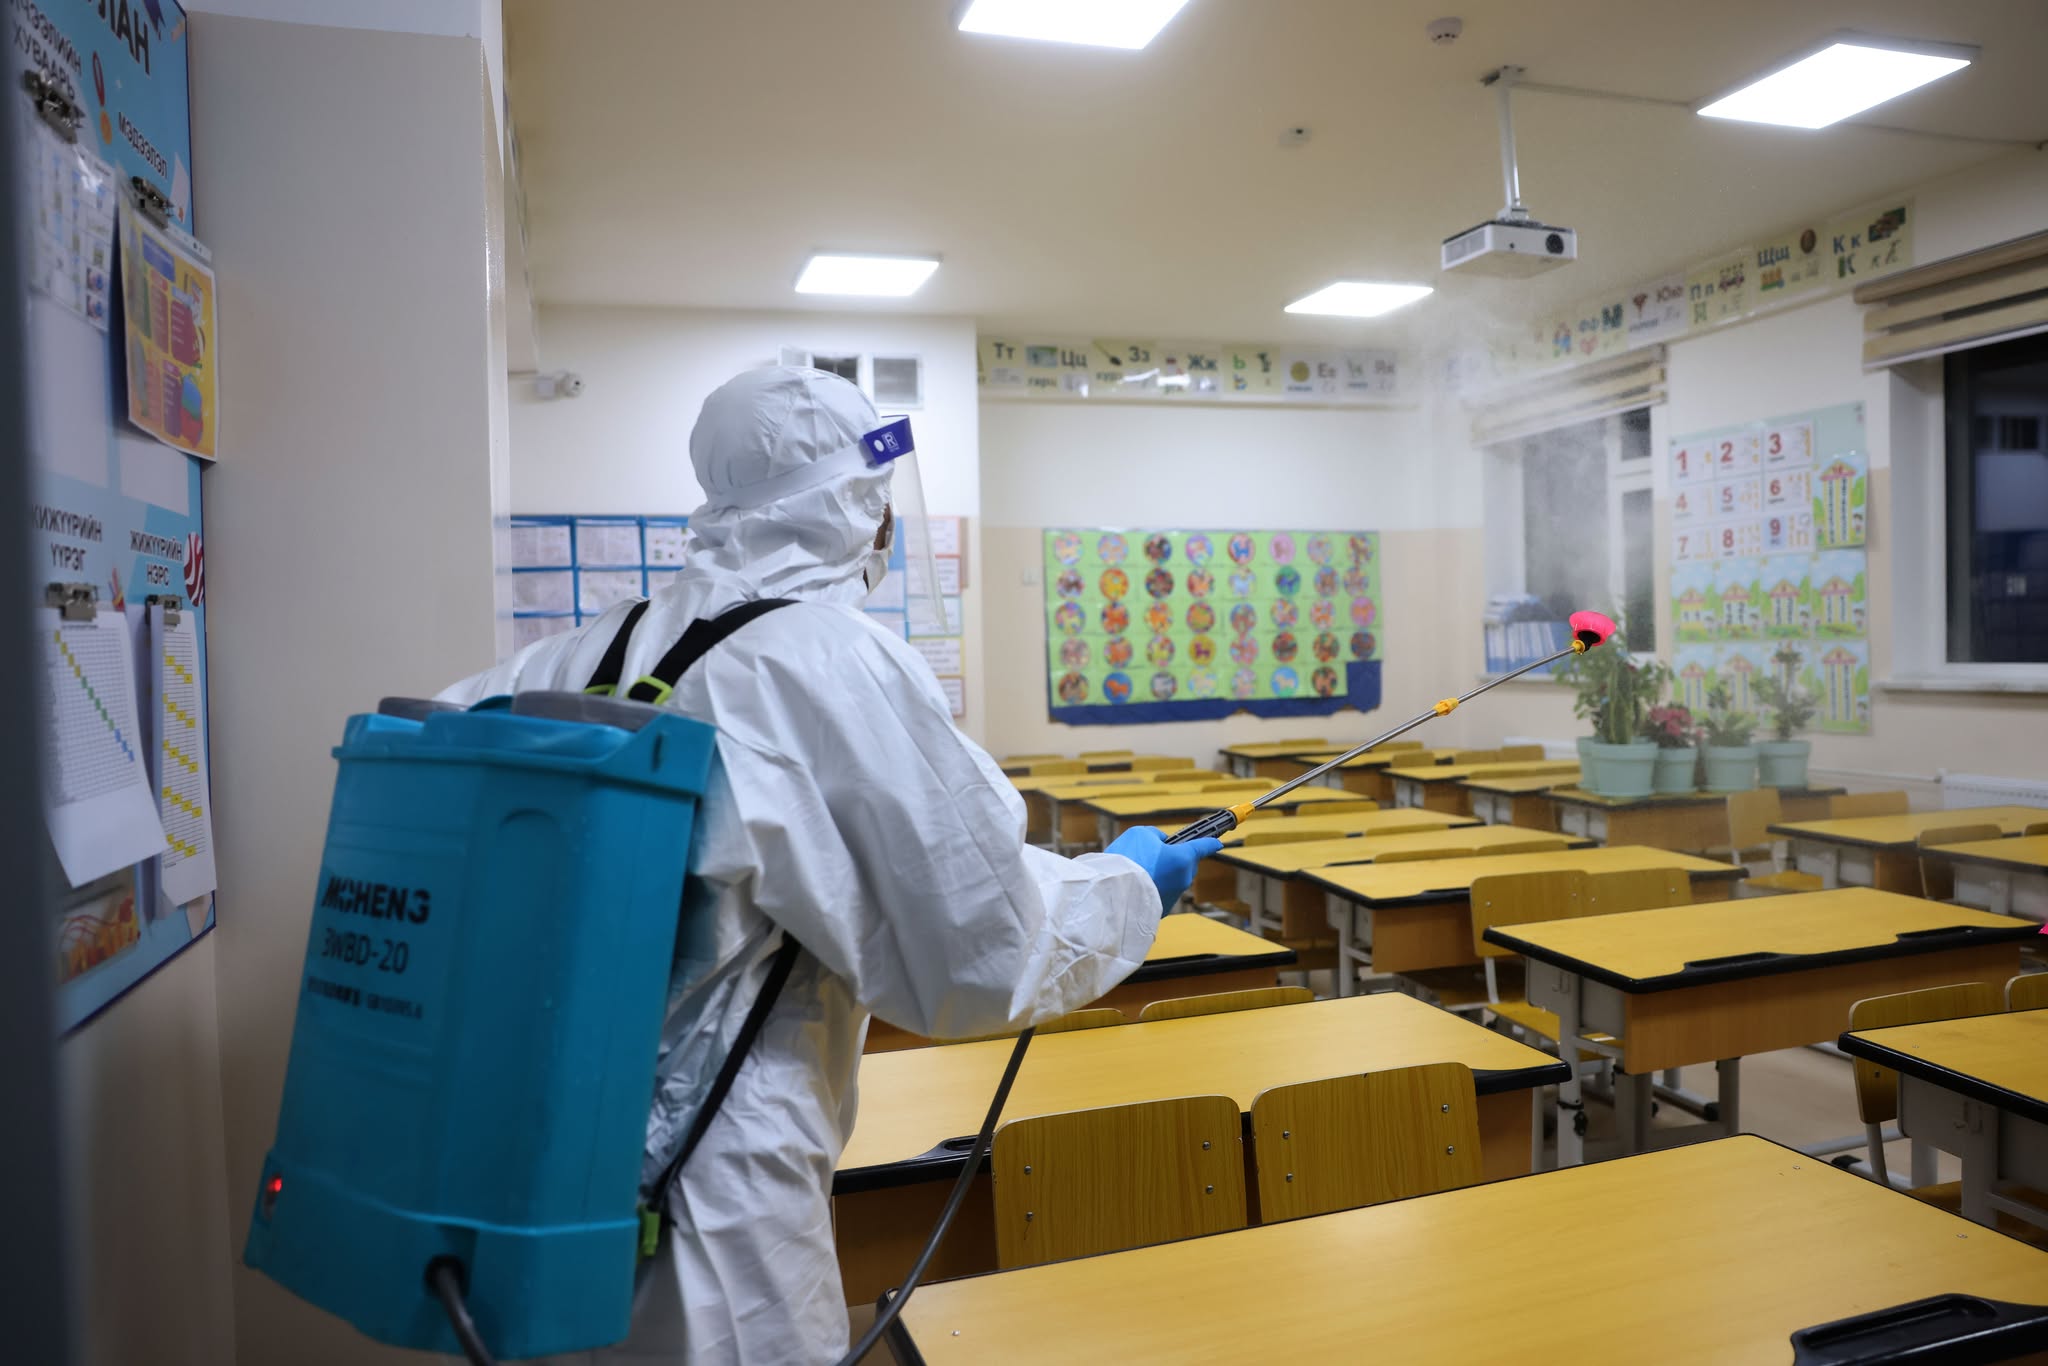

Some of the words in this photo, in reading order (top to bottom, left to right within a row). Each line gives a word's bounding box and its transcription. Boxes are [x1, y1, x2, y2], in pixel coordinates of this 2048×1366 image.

[88, 0, 151, 76] ЛАН
[118, 111, 168, 179] МЭДЭЭЛЭЛ
[993, 341, 1015, 360] Тт
[1720, 441, 1734, 463] 2
[1769, 432, 1782, 455] 3
[1675, 450, 1687, 471] 1
[1722, 486, 1733, 505] 5
[1769, 479, 1781, 496] 6
[1675, 492, 1688, 509] 4
[1769, 517, 1781, 537] 9
[1678, 535, 1689, 554] 7
[1722, 528, 1734, 549] 8
[321, 927, 409, 974] 3WBD-20
